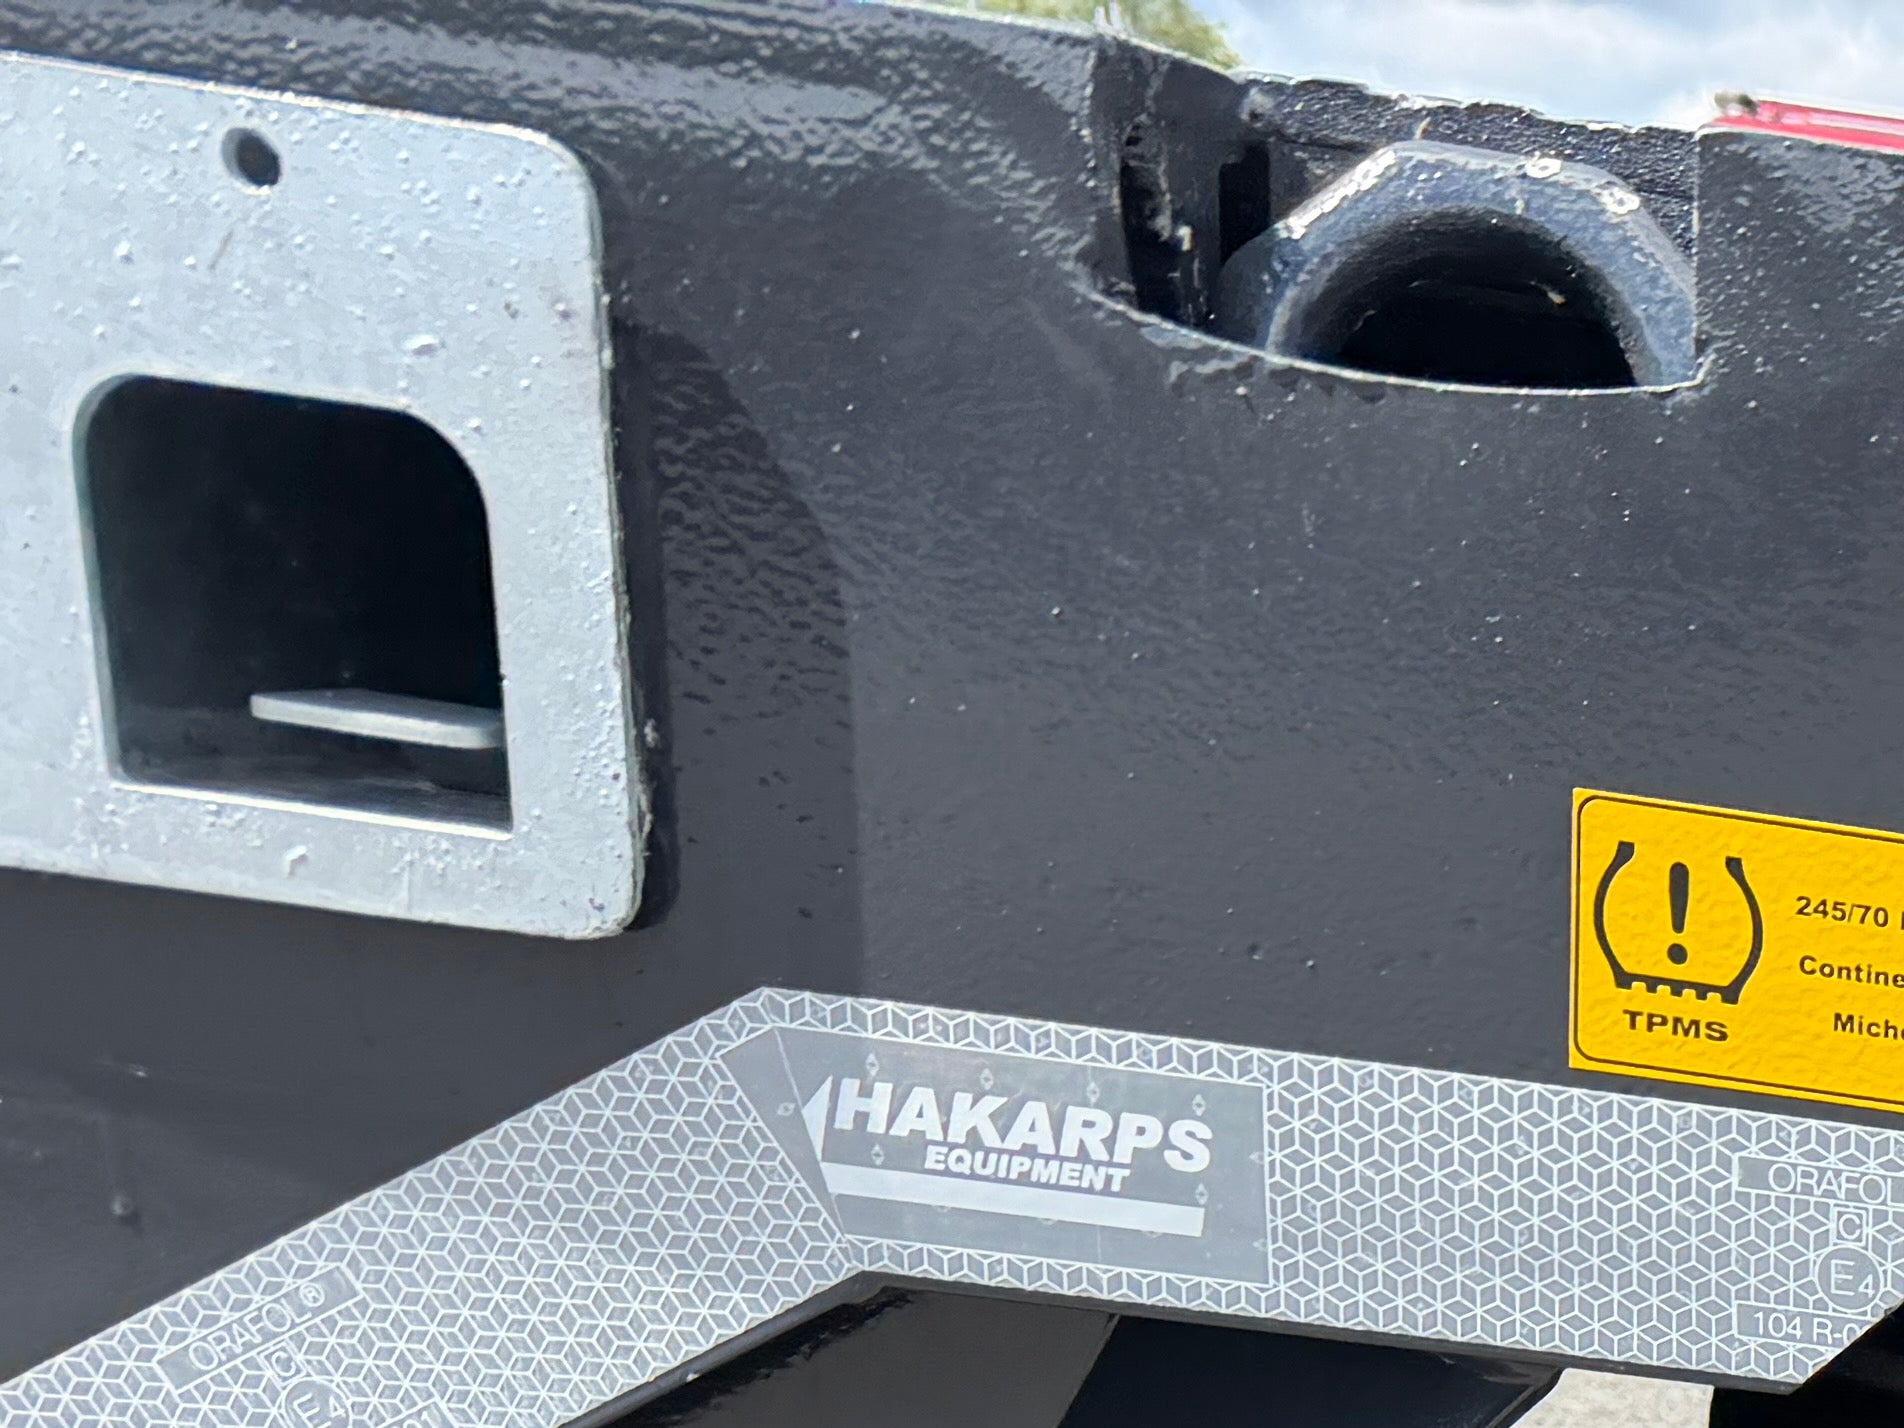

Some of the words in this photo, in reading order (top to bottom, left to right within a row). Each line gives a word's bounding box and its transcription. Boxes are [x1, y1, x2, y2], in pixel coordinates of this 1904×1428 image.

[1796, 896, 1889, 928] 245/70
[1623, 1009, 1728, 1042] TPMS
[834, 1078, 1213, 1173] HAKARPS
[924, 1146, 1131, 1192] EQUIPMENT
[1838, 1213, 1861, 1240] C
[1754, 1311, 1802, 1339] 104
[1813, 1317, 1871, 1344] R-0
[272, 1351, 295, 1377] C
